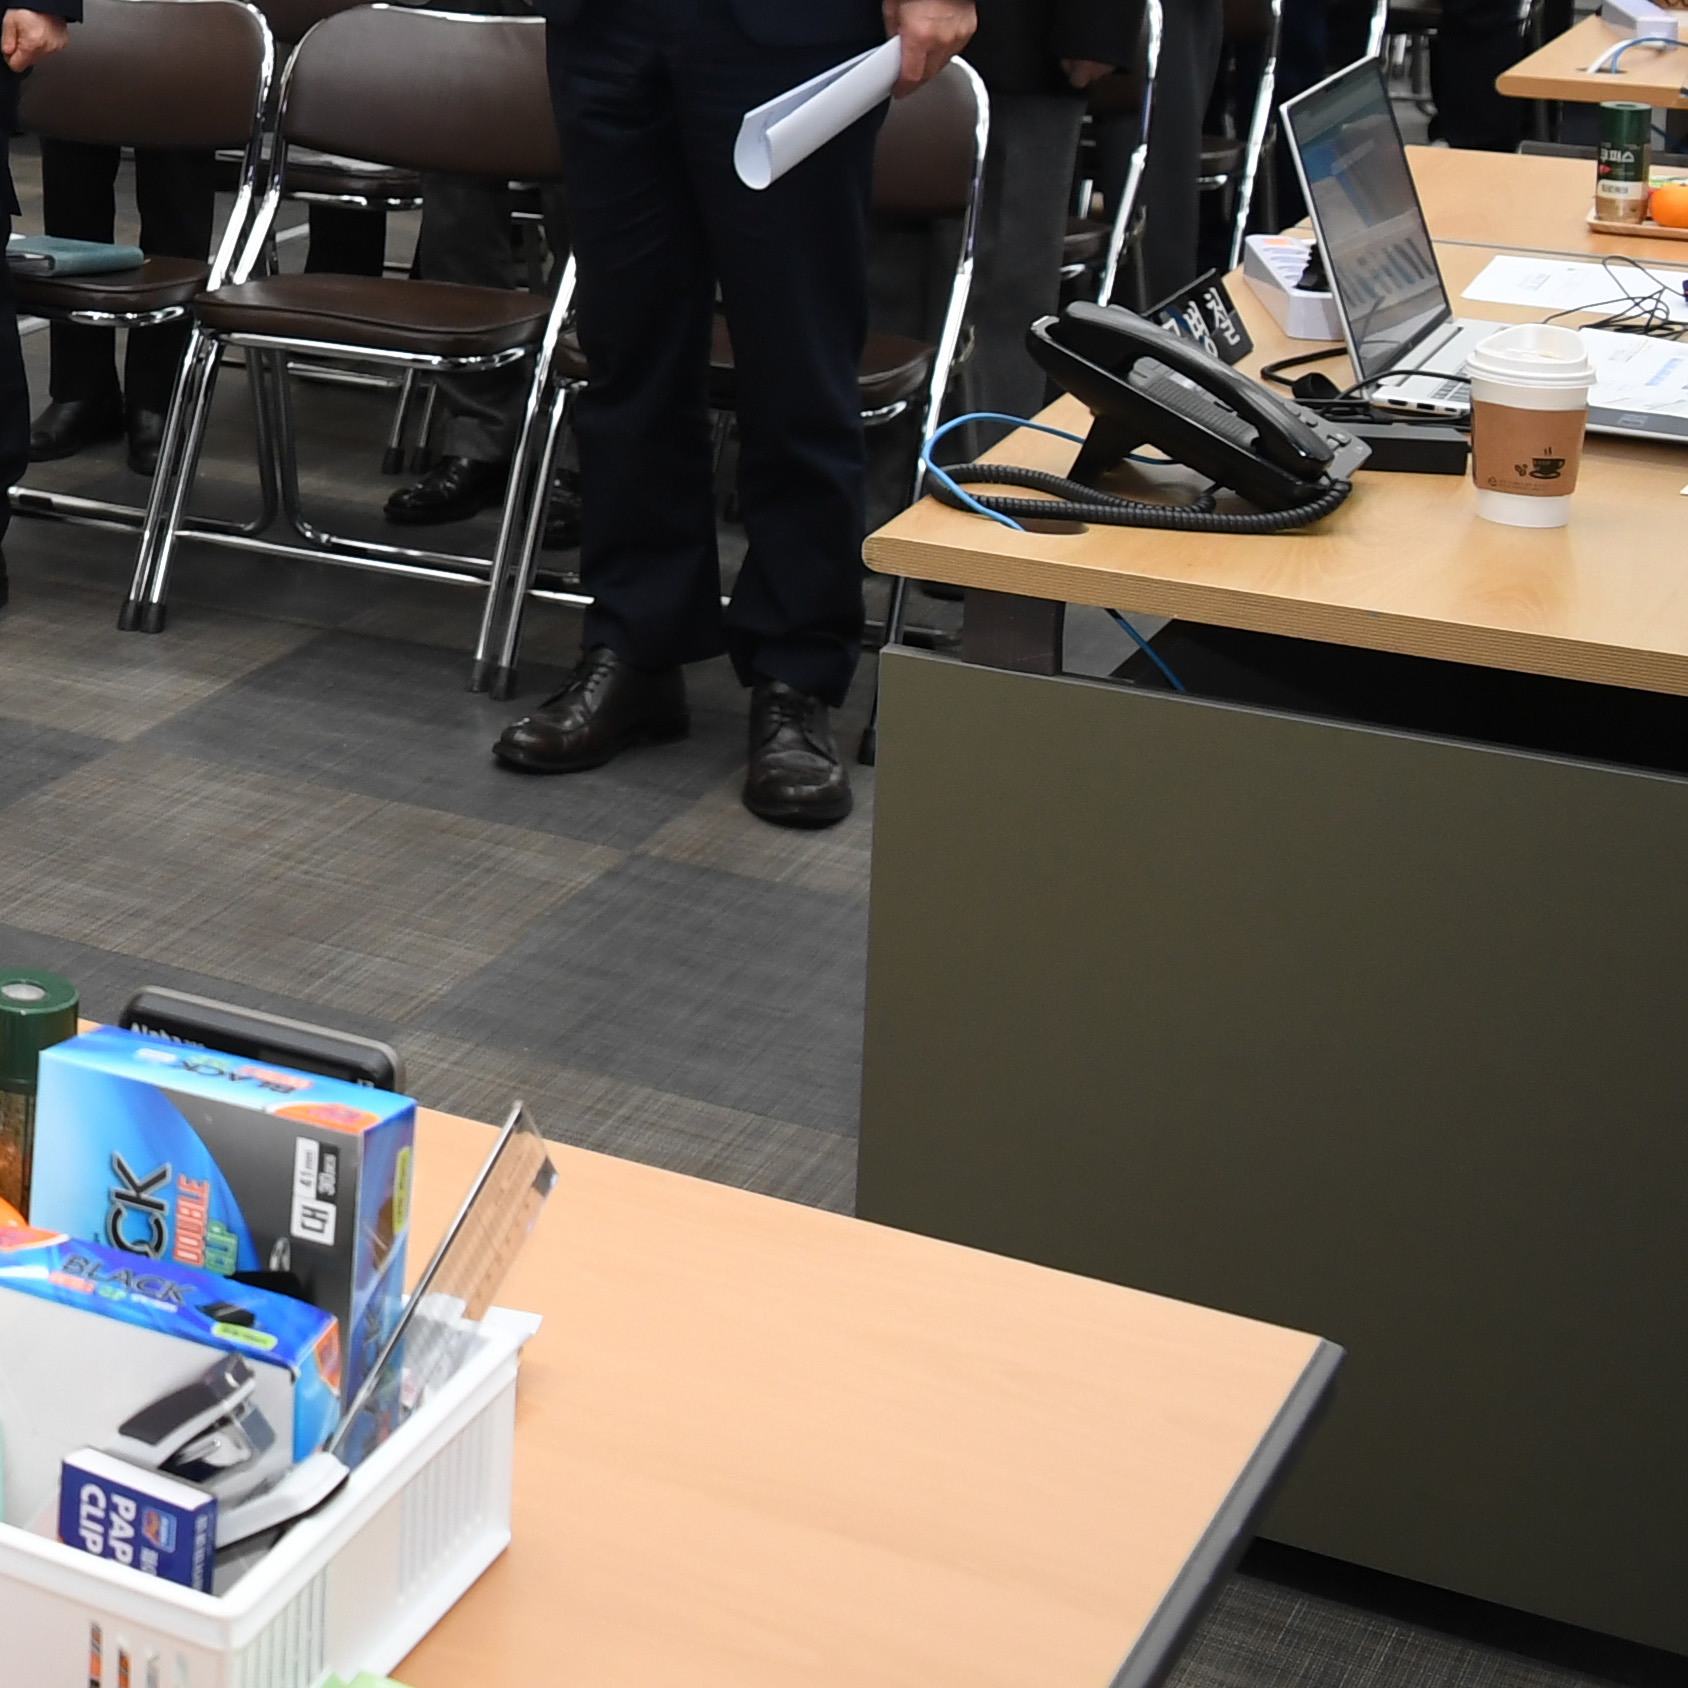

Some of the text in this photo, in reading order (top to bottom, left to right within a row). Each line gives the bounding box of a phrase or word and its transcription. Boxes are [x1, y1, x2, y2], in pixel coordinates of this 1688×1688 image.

[107, 1150, 172, 1258] CK
[174, 1173, 210, 1267] DOUBLE
[61, 1253, 198, 1305] BLACK
[79, 1483, 107, 1555] CLIP
[108, 1492, 137, 1565] PAP
